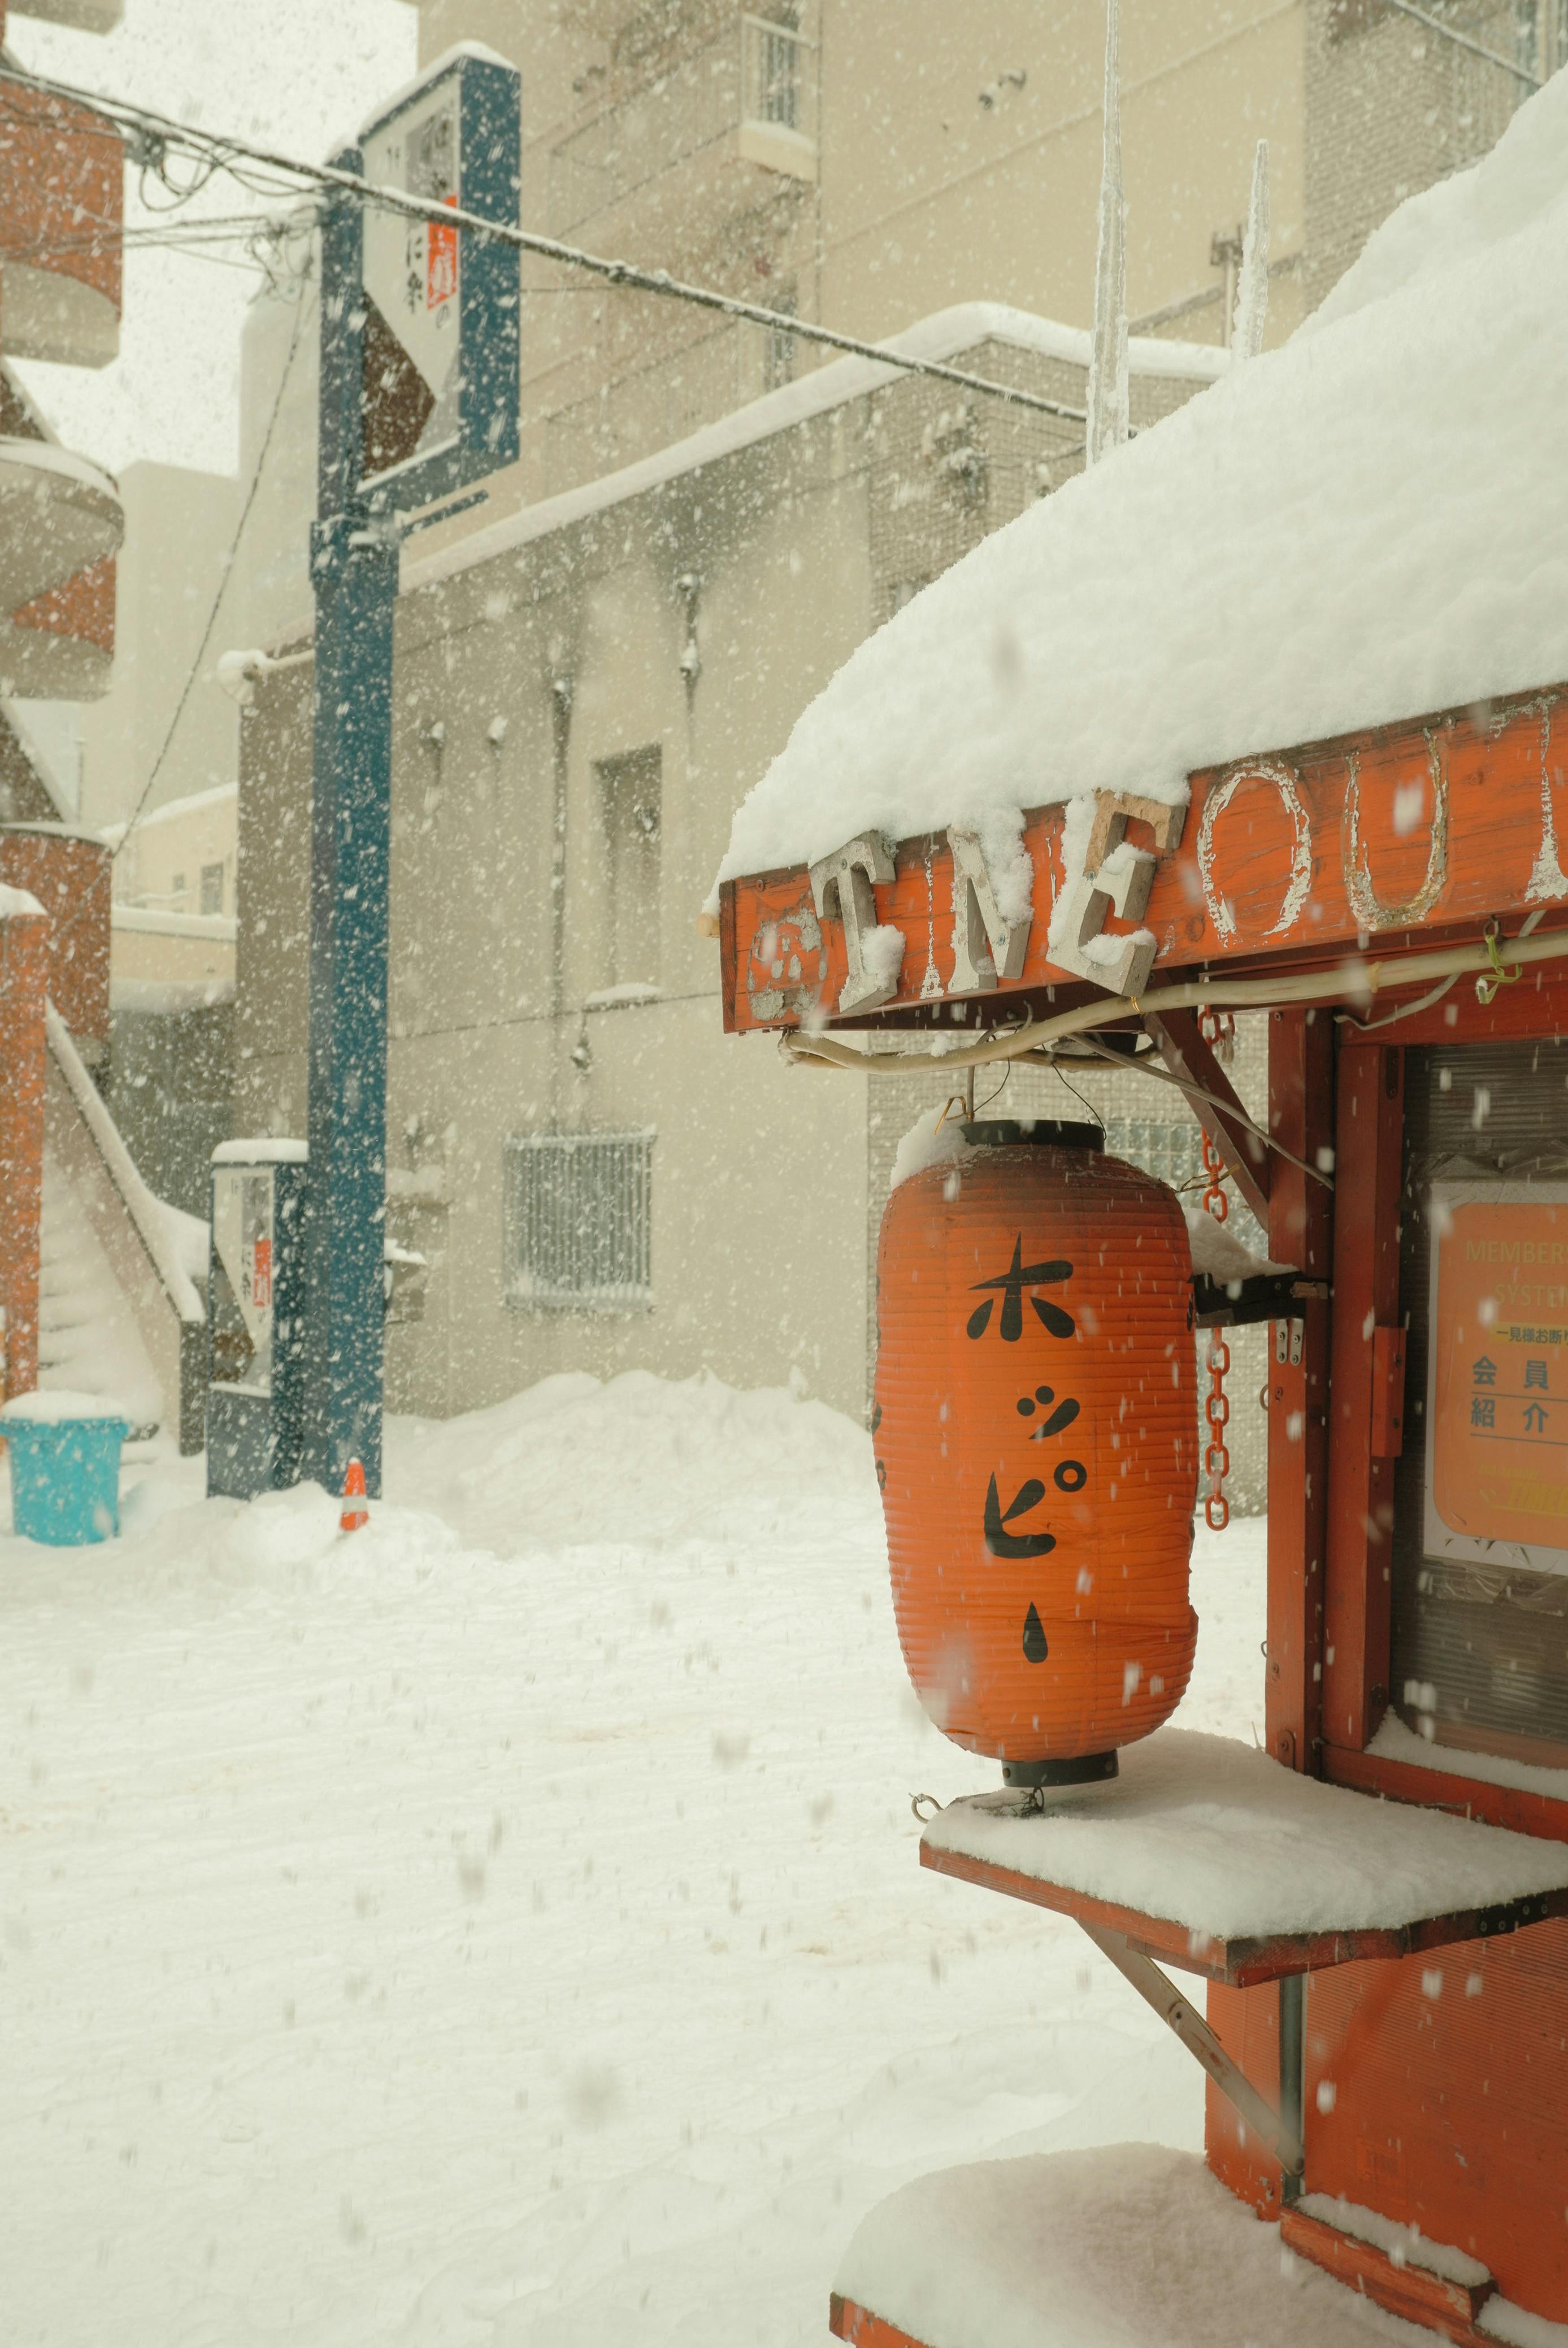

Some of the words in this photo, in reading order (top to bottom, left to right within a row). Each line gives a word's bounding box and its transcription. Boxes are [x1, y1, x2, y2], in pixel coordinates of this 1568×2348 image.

[1465, 1240, 1568, 1266] MEMBER
[967, 1231, 1087, 1664] ホッピー
